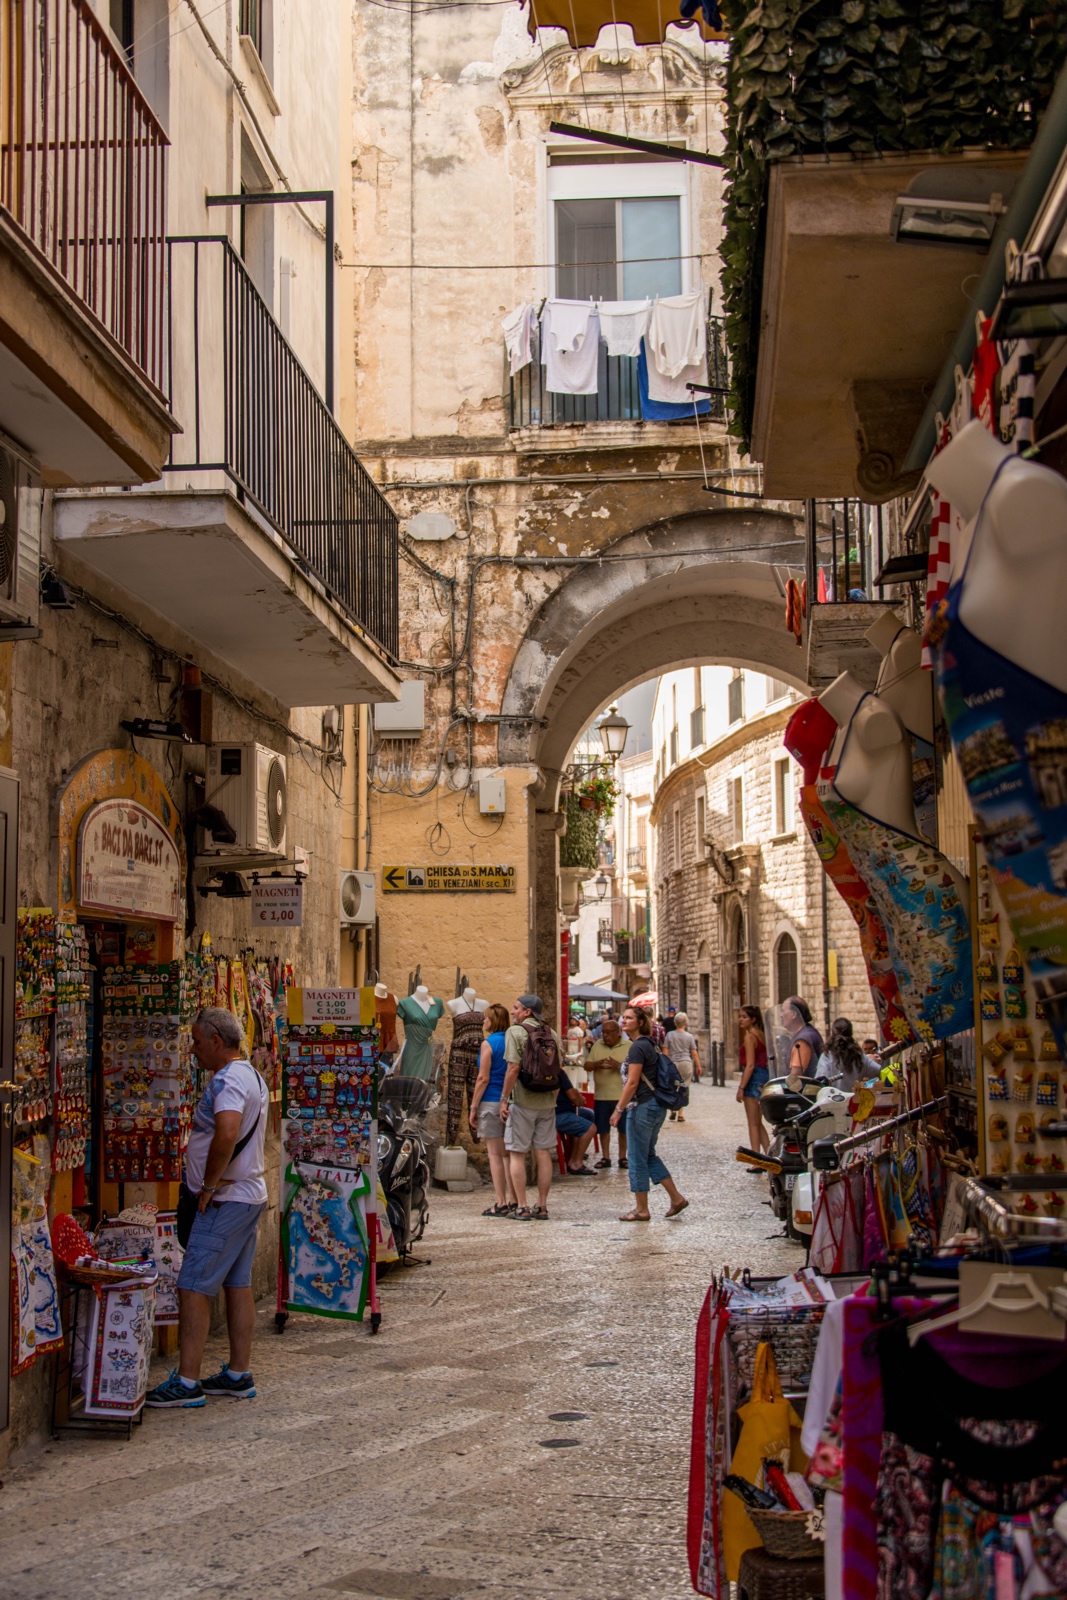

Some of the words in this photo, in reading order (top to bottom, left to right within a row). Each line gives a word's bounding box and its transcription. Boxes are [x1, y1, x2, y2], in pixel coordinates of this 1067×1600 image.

[964, 687, 1005, 708] Vieste
[102, 821, 121, 856] BACI
[122, 828, 134, 859] DA
[134, 832, 164, 868] BARI.IT
[427, 867, 461, 877] CHIESA
[428, 880, 440, 888] DEI
[254, 888, 299, 897] MAGNETI
[260, 910, 267, 920] €
[271, 910, 294, 922] 1,00
[306, 992, 356, 1000] MAGNETI
[120, 1214, 154, 1226] SERVICE
[124, 1227, 152, 1236] PUGLIA
